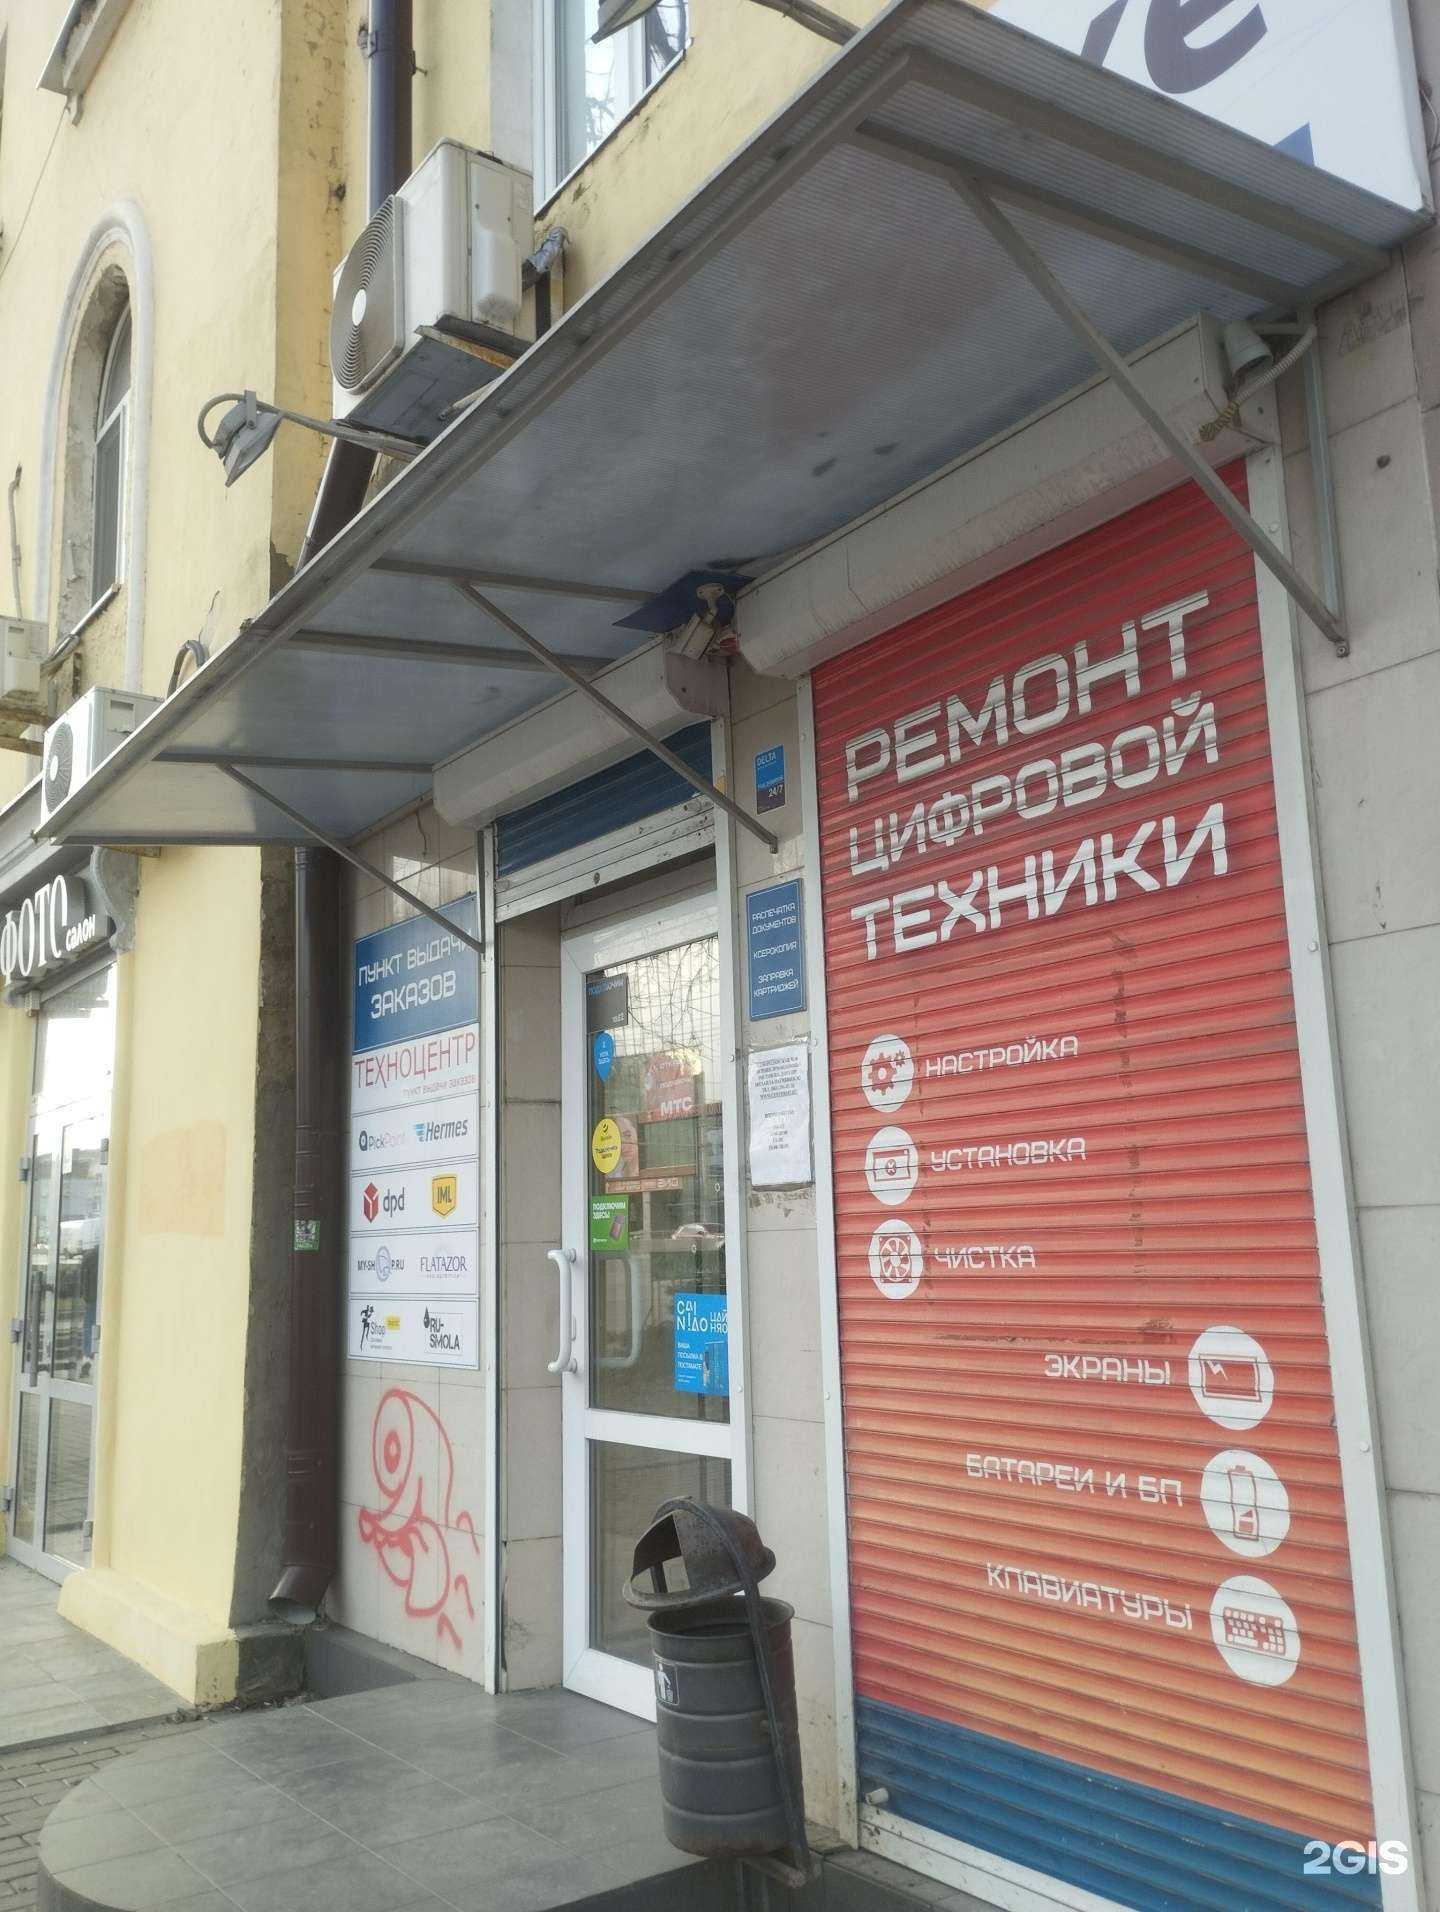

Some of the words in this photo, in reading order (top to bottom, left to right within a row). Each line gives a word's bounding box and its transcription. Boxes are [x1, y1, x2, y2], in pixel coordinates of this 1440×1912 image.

[845, 589, 1209, 802] РЕМОНТ
[849, 690, 1219, 877] ЦИФРОВОЙ
[850, 802, 1228, 960] ТЕХНИКИ
[752, 902, 796, 921] РАСПЕЧАТКА
[752, 915, 797, 935] ДОКУМЕНТОВ
[65, 913, 96, 952] салон
[753, 941, 798, 960] КСЕРОКОПИЯ
[358, 953, 403, 987] ПУНКТ
[758, 968, 794, 984] ЗАПРАВКА
[370, 970, 457, 1020] ЗАКАЗОВ
[354, 1031, 477, 1089] ТЕХНОЦЕНТР
[925, 1035, 1079, 1078] НАСТРОЙКА
[425, 1119, 469, 1142] Hermes
[930, 1136, 1087, 1172] УСТАНОВКА
[382, 1186, 406, 1218] dpd
[437, 1185, 453, 1204] IML
[420, 1255, 468, 1272] FLATAZOR
[934, 1245, 1036, 1269] ЧИСТКА
[429, 1333, 461, 1350] SMOLA
[1043, 1353, 1171, 1385] ЭКРАНЫ
[966, 1453, 1095, 1494] БАТАРЕИ
[1106, 1470, 1127, 1499] И
[1138, 1476, 1184, 1507] БП
[985, 1562, 1193, 1631] КЛАВИАТУРЫ
